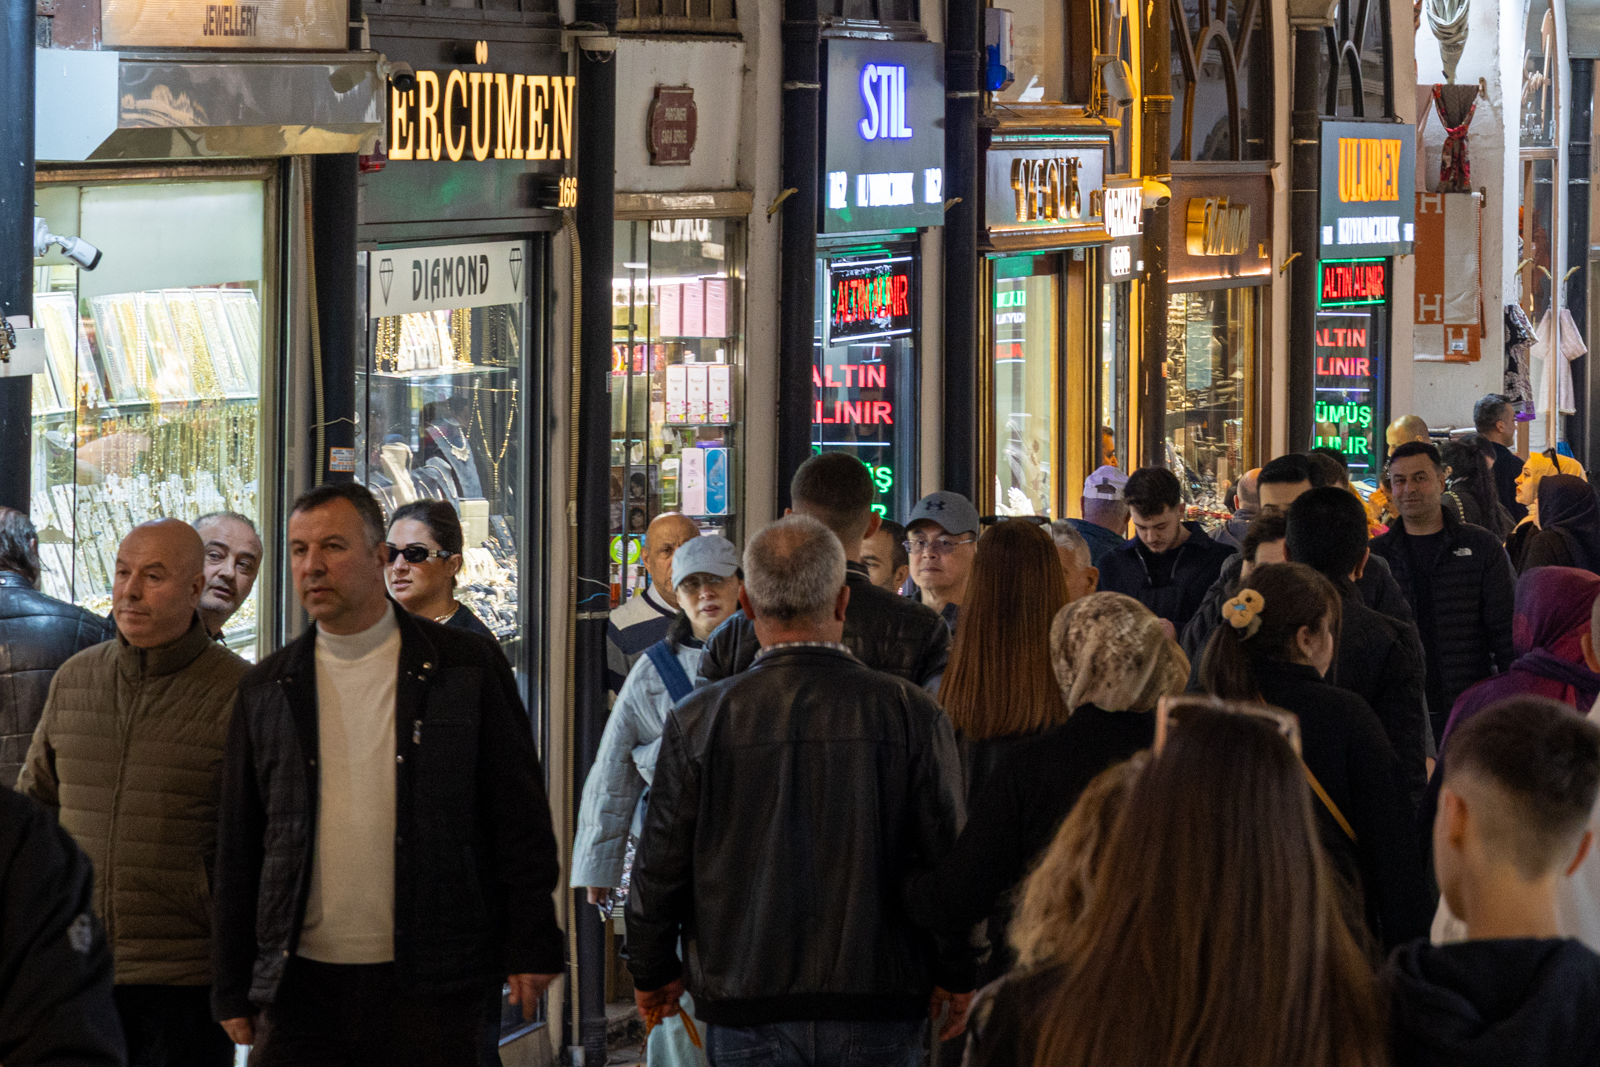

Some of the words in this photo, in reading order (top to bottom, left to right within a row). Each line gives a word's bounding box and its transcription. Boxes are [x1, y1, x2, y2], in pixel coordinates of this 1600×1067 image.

[203, 5, 259, 37] JEWELLERY
[1338, 137, 1402, 203] ULUBEY
[558, 176, 578, 208] 166
[412, 254, 489, 304] DIAMOND
[1323, 266, 1353, 299] ALTIN
[1353, 265, 1385, 297] ALINIR
[1314, 357, 1370, 376] LINIR
[812, 400, 894, 425] LINIR
[1315, 401, 1372, 428] ÜMÜŞ
